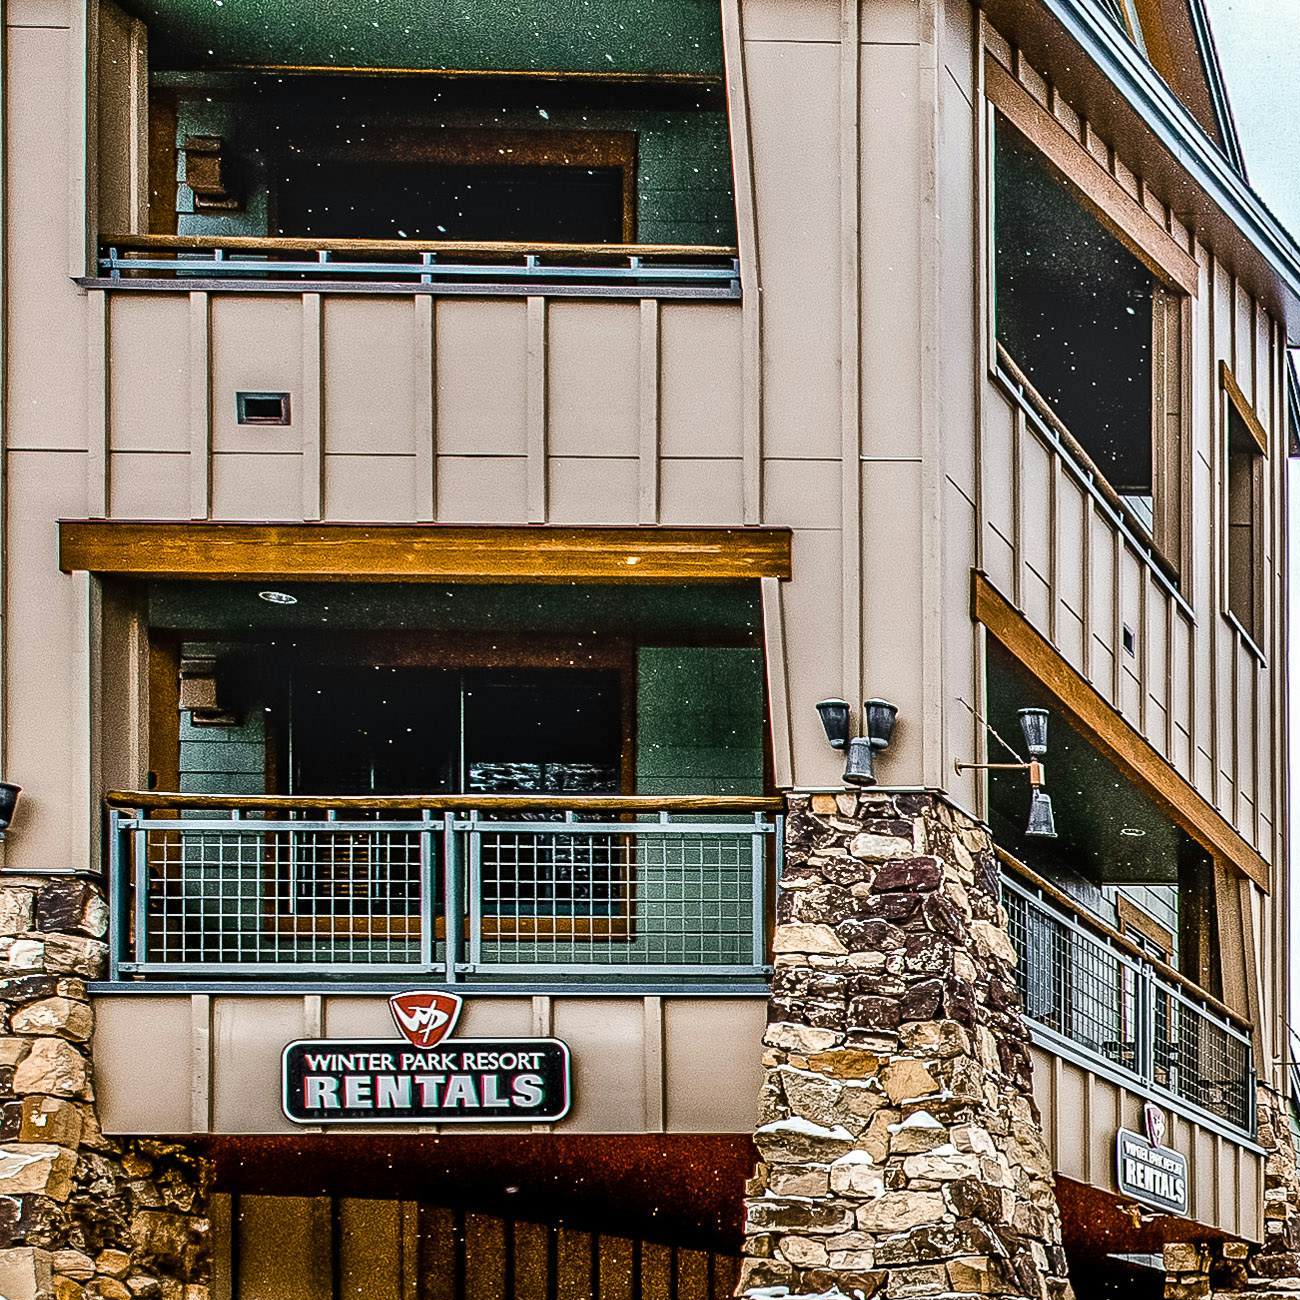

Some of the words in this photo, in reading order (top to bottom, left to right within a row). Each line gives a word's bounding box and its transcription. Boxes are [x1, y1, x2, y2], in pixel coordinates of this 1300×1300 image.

[305, 1054, 395, 1072] WINTER
[402, 1053, 457, 1071] PARK
[463, 1052, 545, 1071] RESORT
[304, 1074, 545, 1109] RENTALS
[1125, 1158, 1185, 1204] RENTALS
